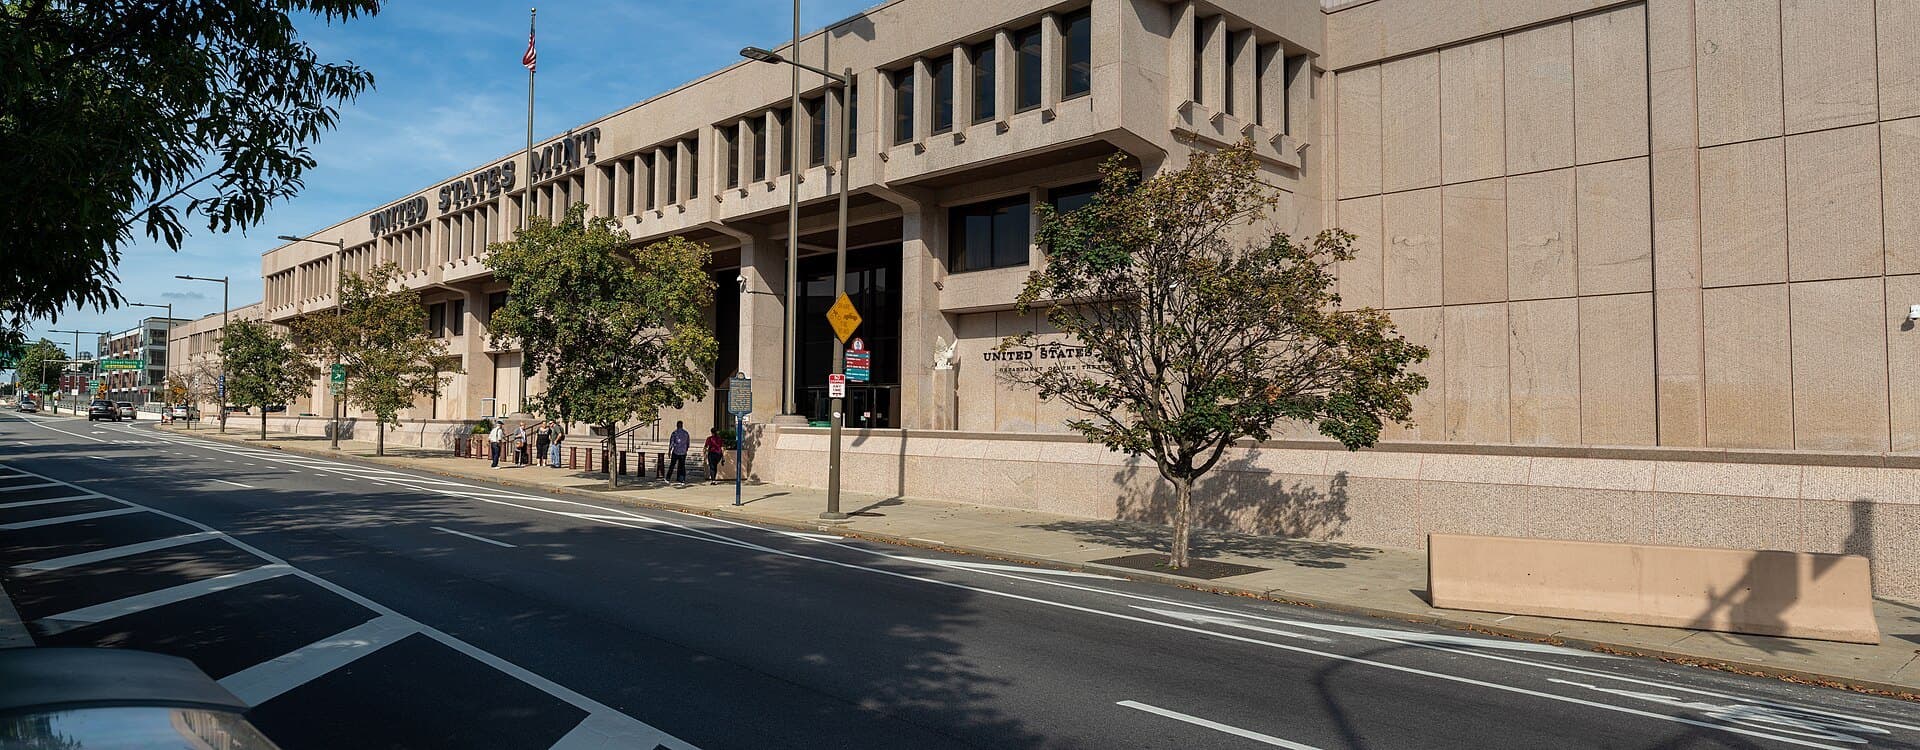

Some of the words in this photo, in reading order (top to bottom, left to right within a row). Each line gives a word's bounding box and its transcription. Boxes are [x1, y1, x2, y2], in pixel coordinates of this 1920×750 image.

[369, 195, 428, 237] UNITED
[438, 160, 516, 213] STATES
[531, 127, 600, 182] MINT
[983, 351, 1032, 361] UNITED
[1040, 348, 1092, 359] STATES
